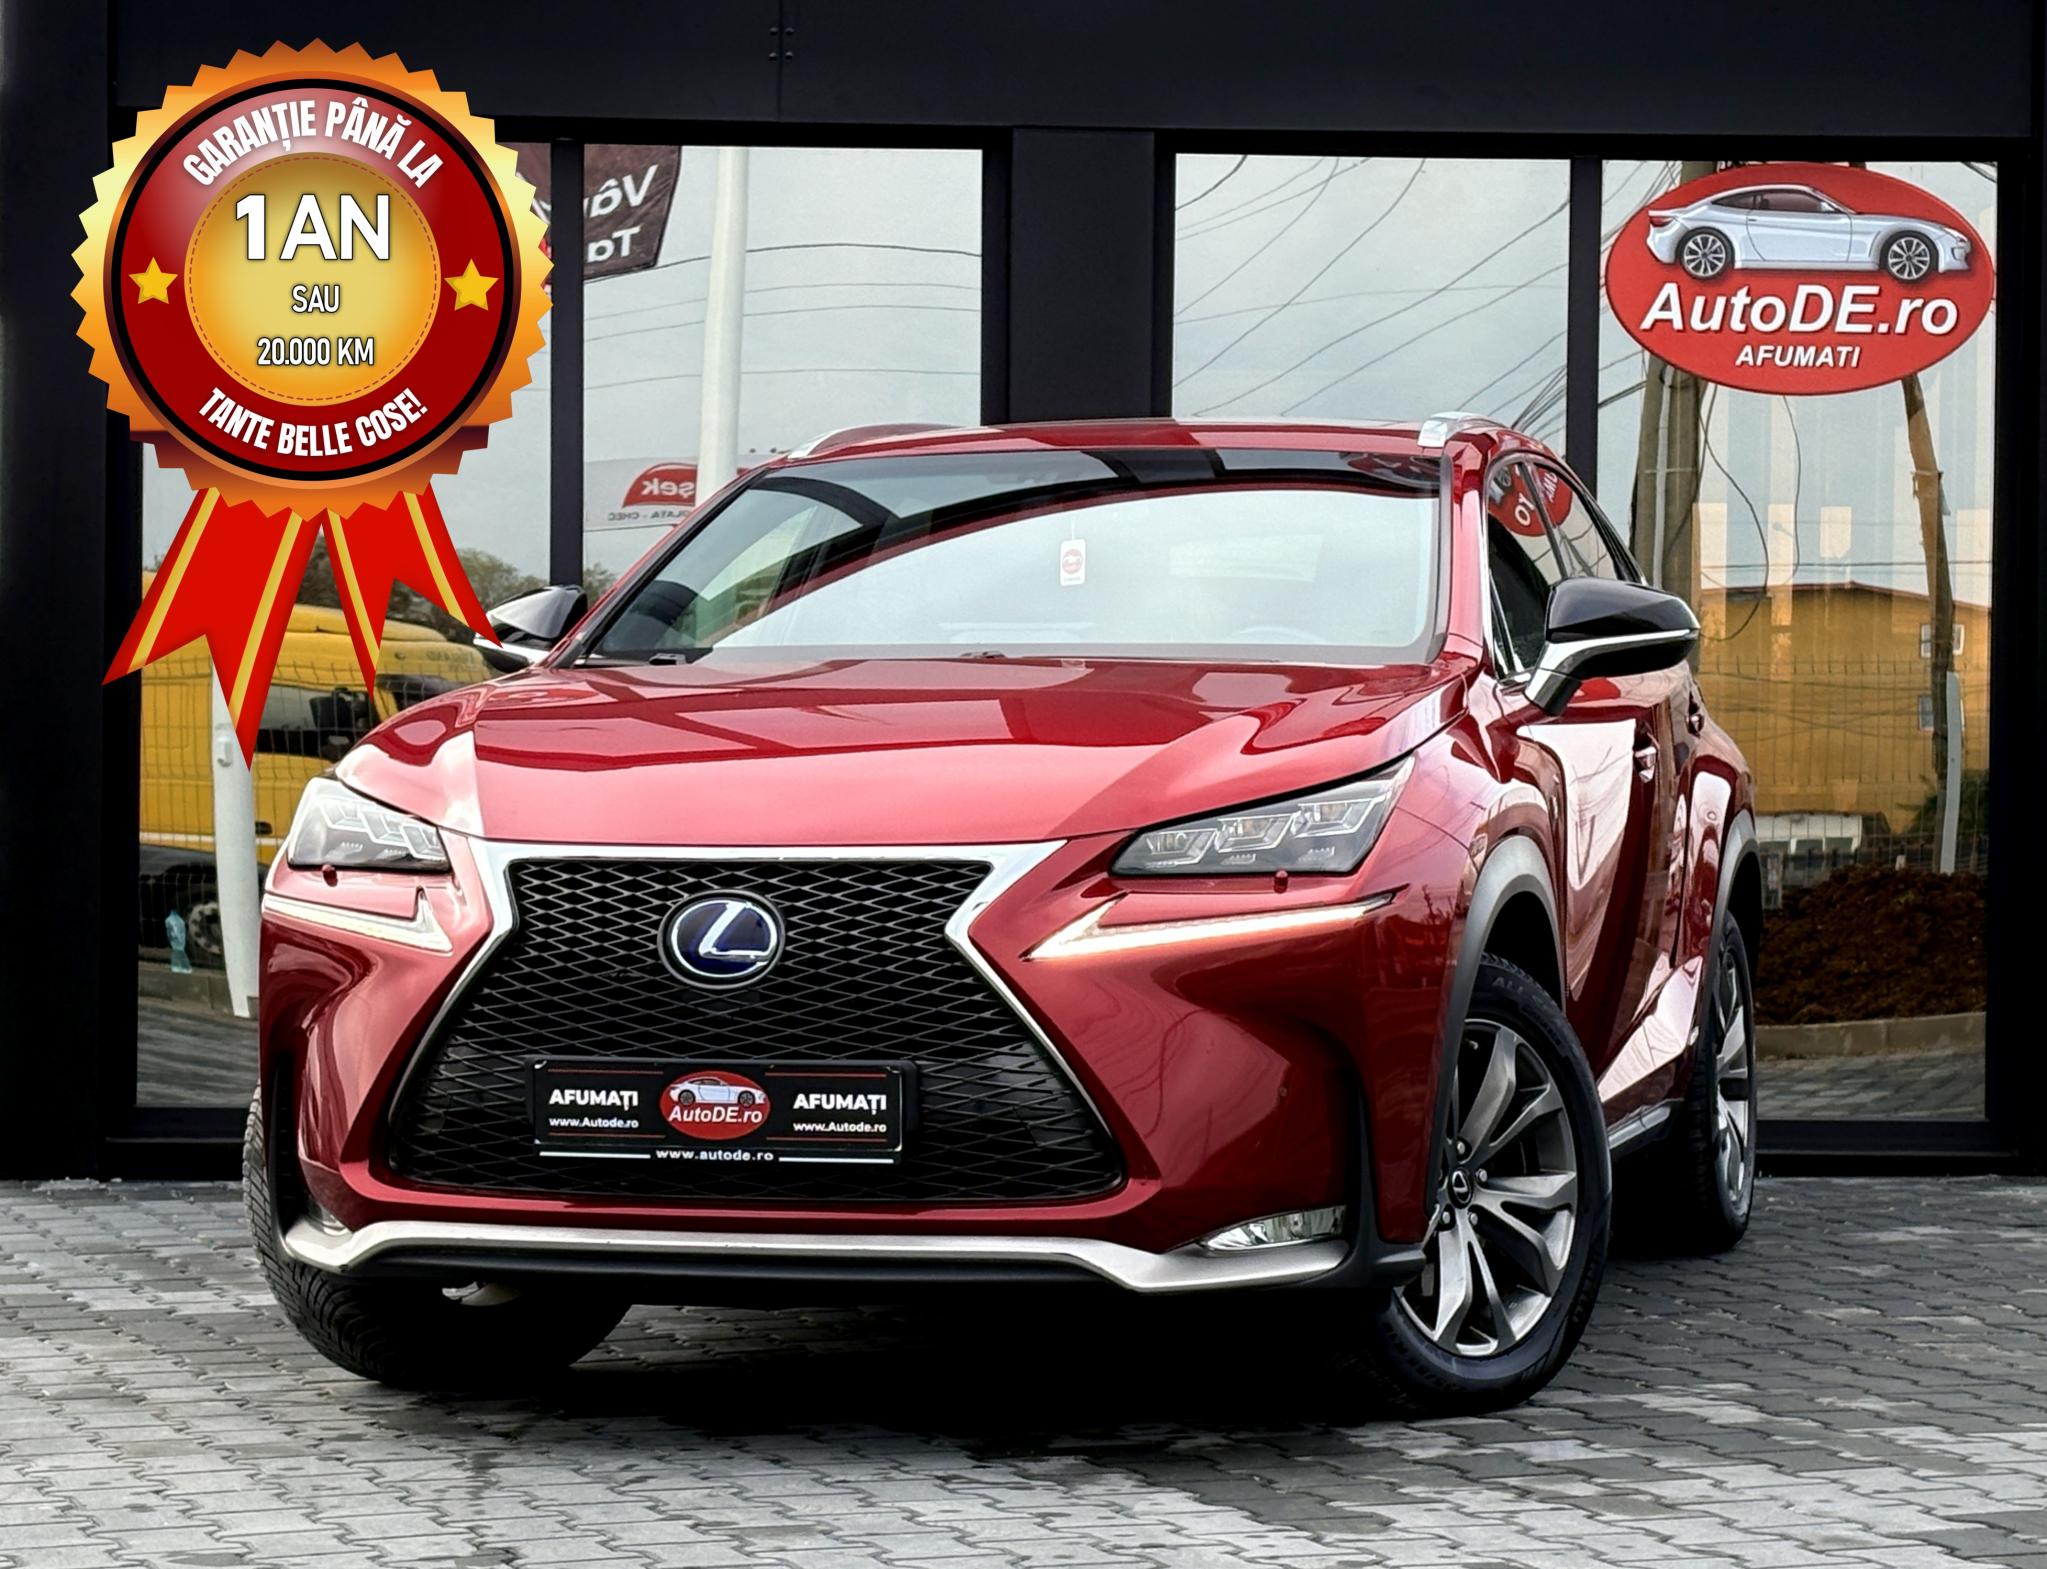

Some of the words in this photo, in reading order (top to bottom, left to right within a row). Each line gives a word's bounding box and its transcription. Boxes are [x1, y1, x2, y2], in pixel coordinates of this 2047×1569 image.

[1639, 281, 1959, 335] AutoDE.ro
[1735, 344, 1861, 368] AFUMATI
[549, 1116, 639, 1129] www.Autode.ro
[668, 1106, 763, 1124] AutoDE.ro
[793, 1120, 887, 1134] www.Autode.ro
[656, 1148, 774, 1162] www.autode.ro
